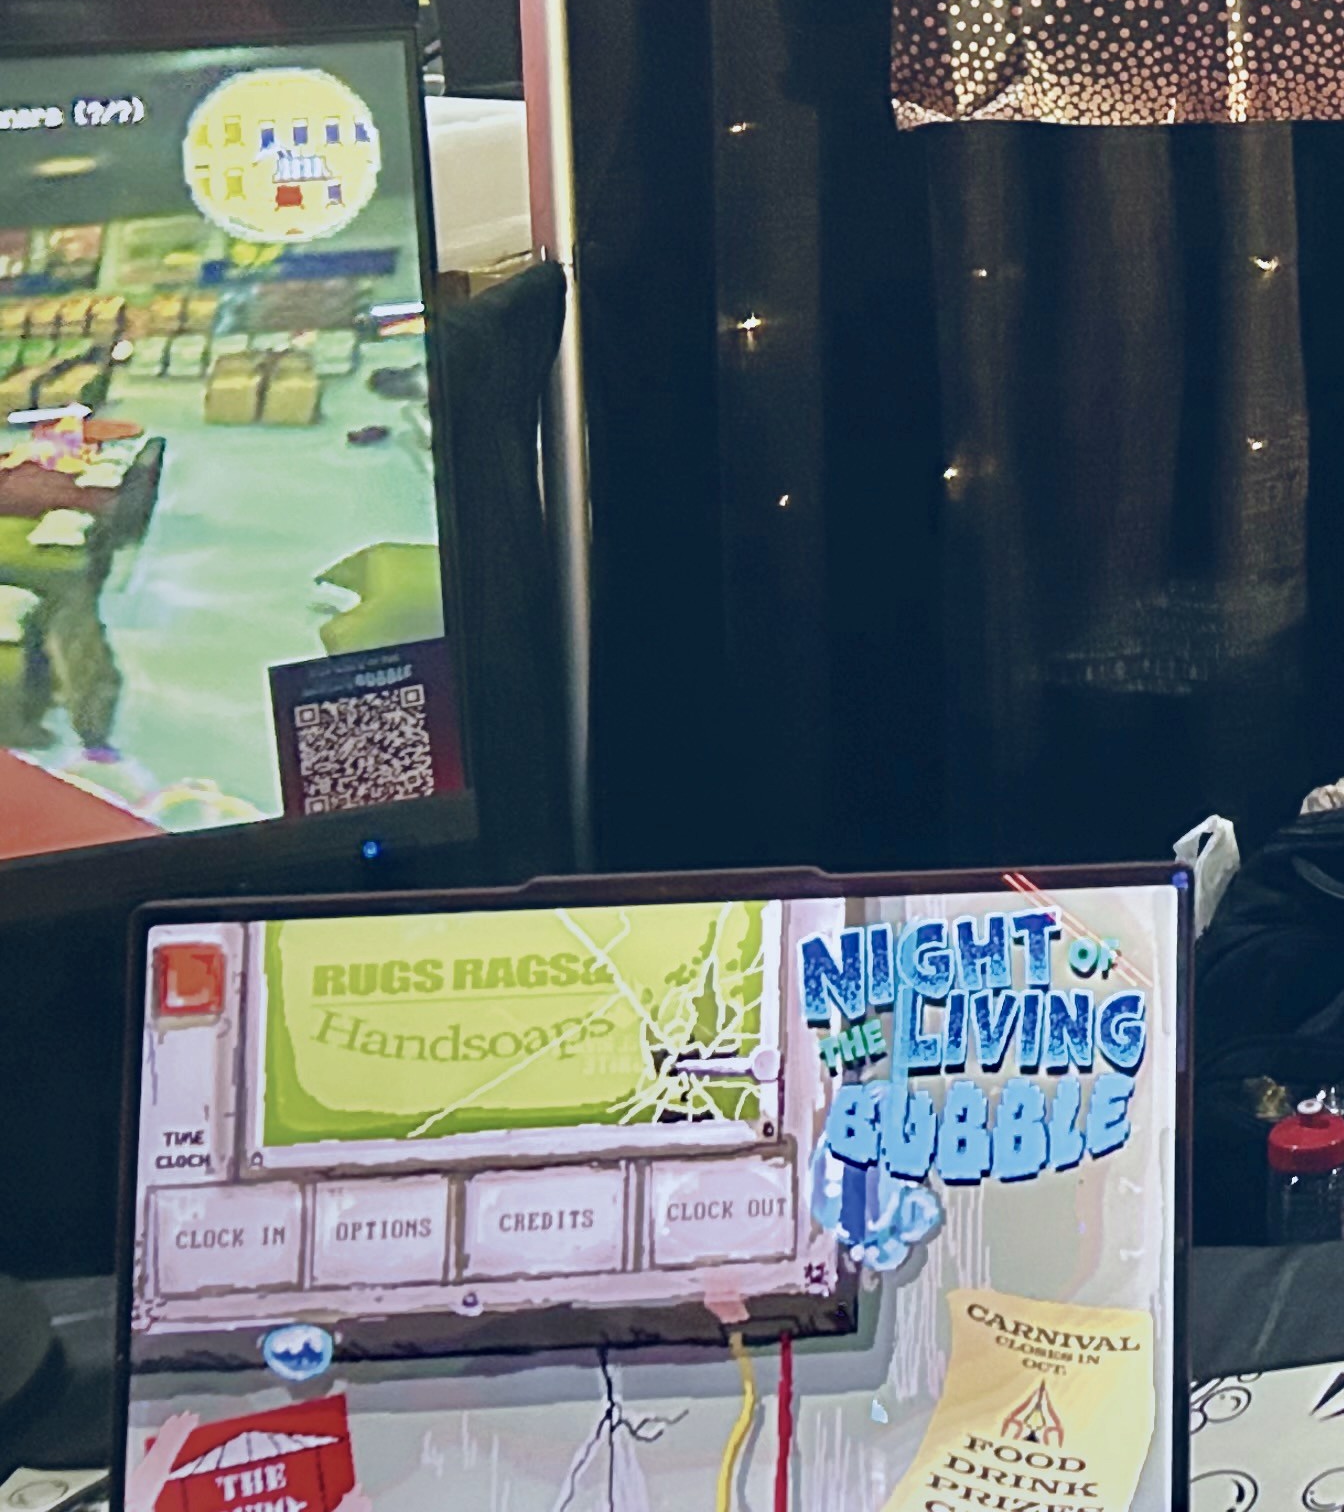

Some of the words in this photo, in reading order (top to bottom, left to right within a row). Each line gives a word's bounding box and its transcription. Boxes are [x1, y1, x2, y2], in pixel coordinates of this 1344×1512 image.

[312, 958, 445, 998] RUGS
[797, 905, 1062, 1029] NIGHT
[1068, 937, 1120, 979] OF
[309, 1010, 616, 1062] Handsoaps
[819, 1019, 887, 1077] THE
[894, 988, 1146, 1077] LIVING
[163, 1130, 204, 1147] TIME
[826, 1073, 1135, 1187] BUBBLE
[335, 1217, 433, 1242] OPTIONS
[499, 1209, 594, 1233] CREDITS
[666, 1200, 735, 1222] CLOCK
[748, 1197, 787, 1219] OUT
[175, 1228, 244, 1249] CLOCK
[260, 1225, 286, 1246] IN
[967, 1303, 1140, 1352] CARNIVAL
[995, 1335, 1073, 1362] CLOSES
[1078, 1352, 1100, 1365] IN
[964, 1432, 1086, 1473] FOOD
[215, 1463, 287, 1502] THE
[944, 1451, 1099, 1498] DRINK
